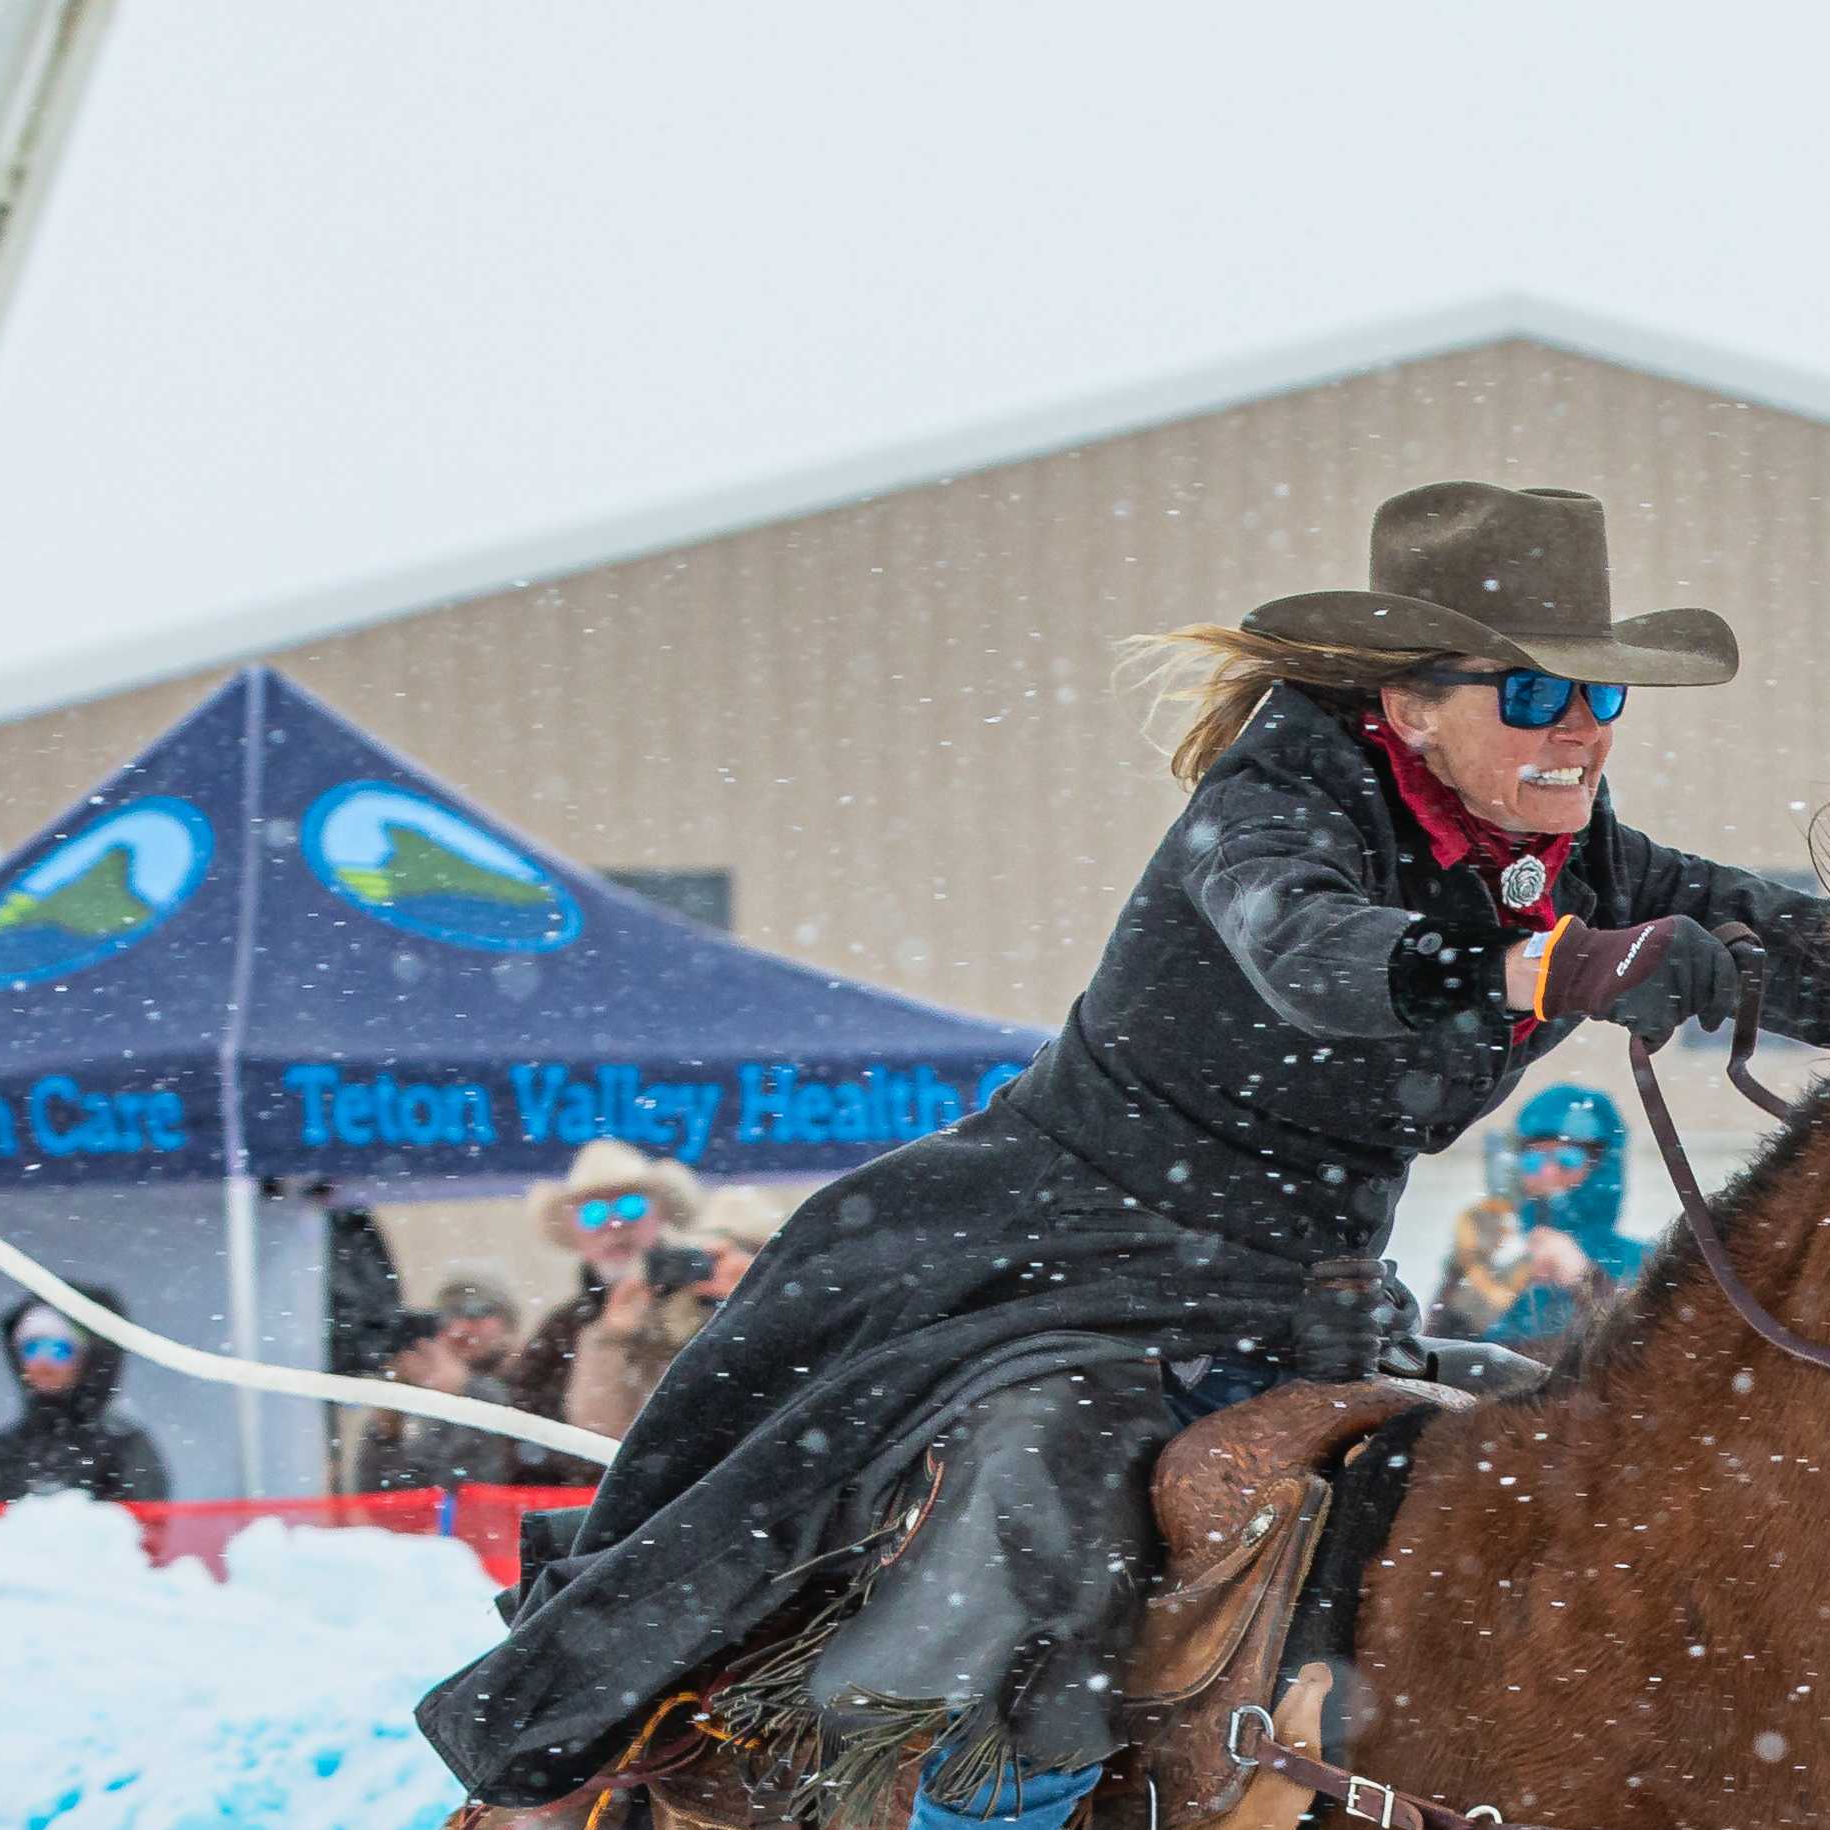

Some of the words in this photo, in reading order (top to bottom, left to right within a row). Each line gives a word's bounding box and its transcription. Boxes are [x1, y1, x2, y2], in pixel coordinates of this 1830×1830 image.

[29, 1075, 187, 1156] Care
[283, 1063, 497, 1146] Teton
[509, 1063, 722, 1164] Valley
[737, 1063, 962, 1144] Health
